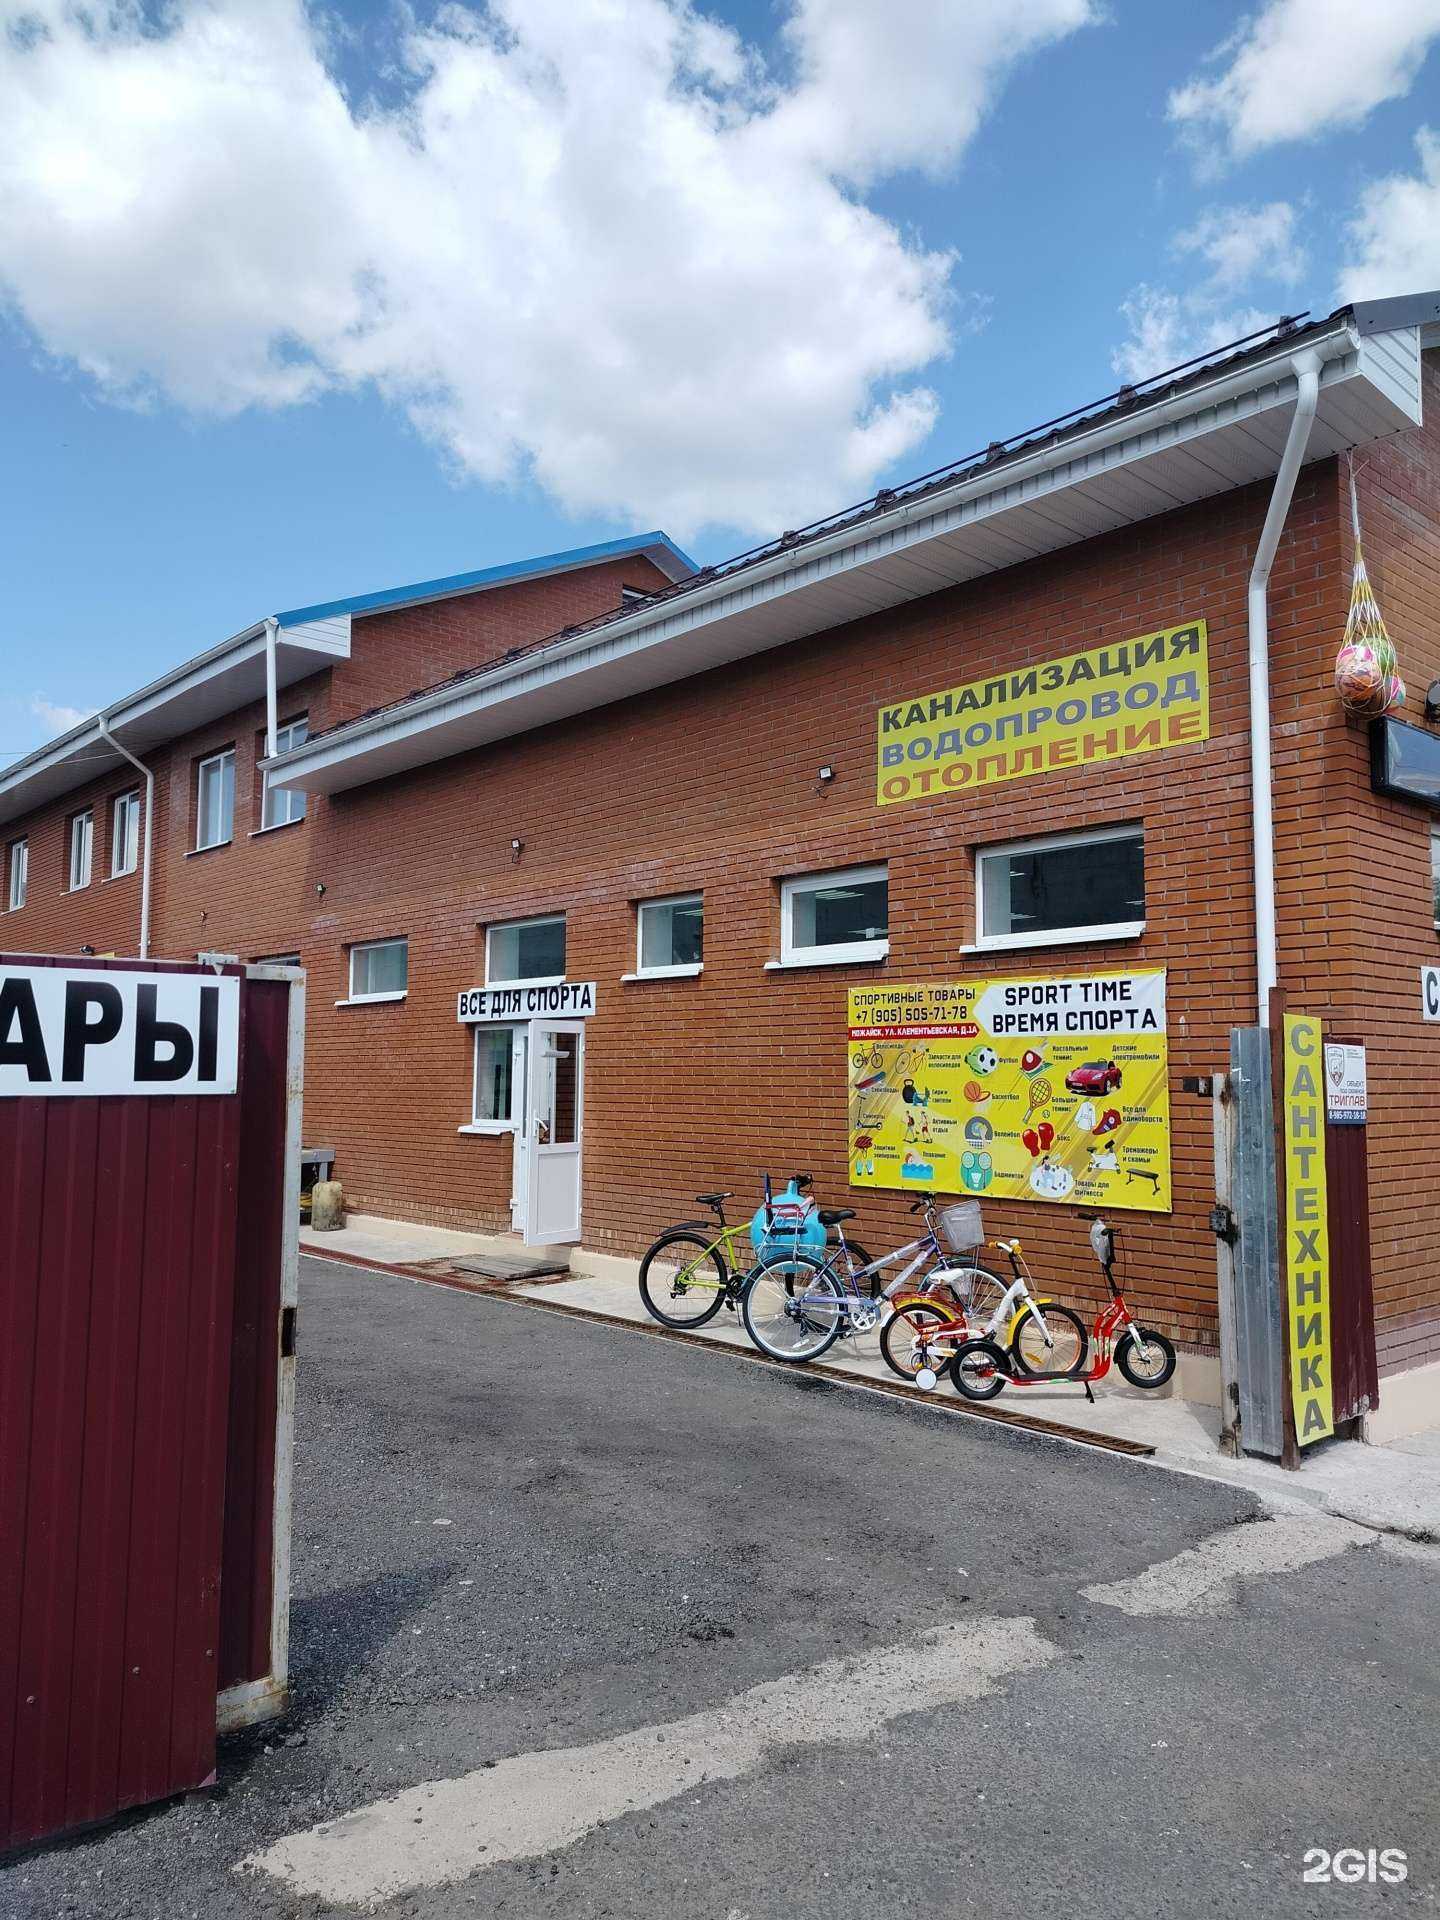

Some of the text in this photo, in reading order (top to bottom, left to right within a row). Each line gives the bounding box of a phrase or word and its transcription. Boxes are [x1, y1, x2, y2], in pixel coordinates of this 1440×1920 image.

[882, 626, 1200, 733] КАНАЛИЗАЦИЯ
[882, 670, 1200, 768] ВОДОПРОВОД
[882, 710, 1202, 800] ОТОПЛЕНИЕ
[460, 984, 592, 1018] ВСЕ ДЛЯ СПОРТА
[854, 988, 975, 1006] СПОРТИВНЫЕ ТОВАРЫ
[1005, 980, 1132, 1006] SPORT TIME
[856, 1010, 868, 1023] +7
[905, 1005, 967, 1021] 505-71-78
[992, 1008, 1157, 1033] ВРЕМЯ СПОРТА
[851, 1028, 884, 1038] МОЖАЙСК,
[885, 1027, 897, 1036] УЛ.
[1112, 1044, 1137, 1052] Детские
[1328, 1094, 1365, 1107] ТРИГЛАВ
[1290, 1023, 1328, 1438] САНТЕХНИКА
